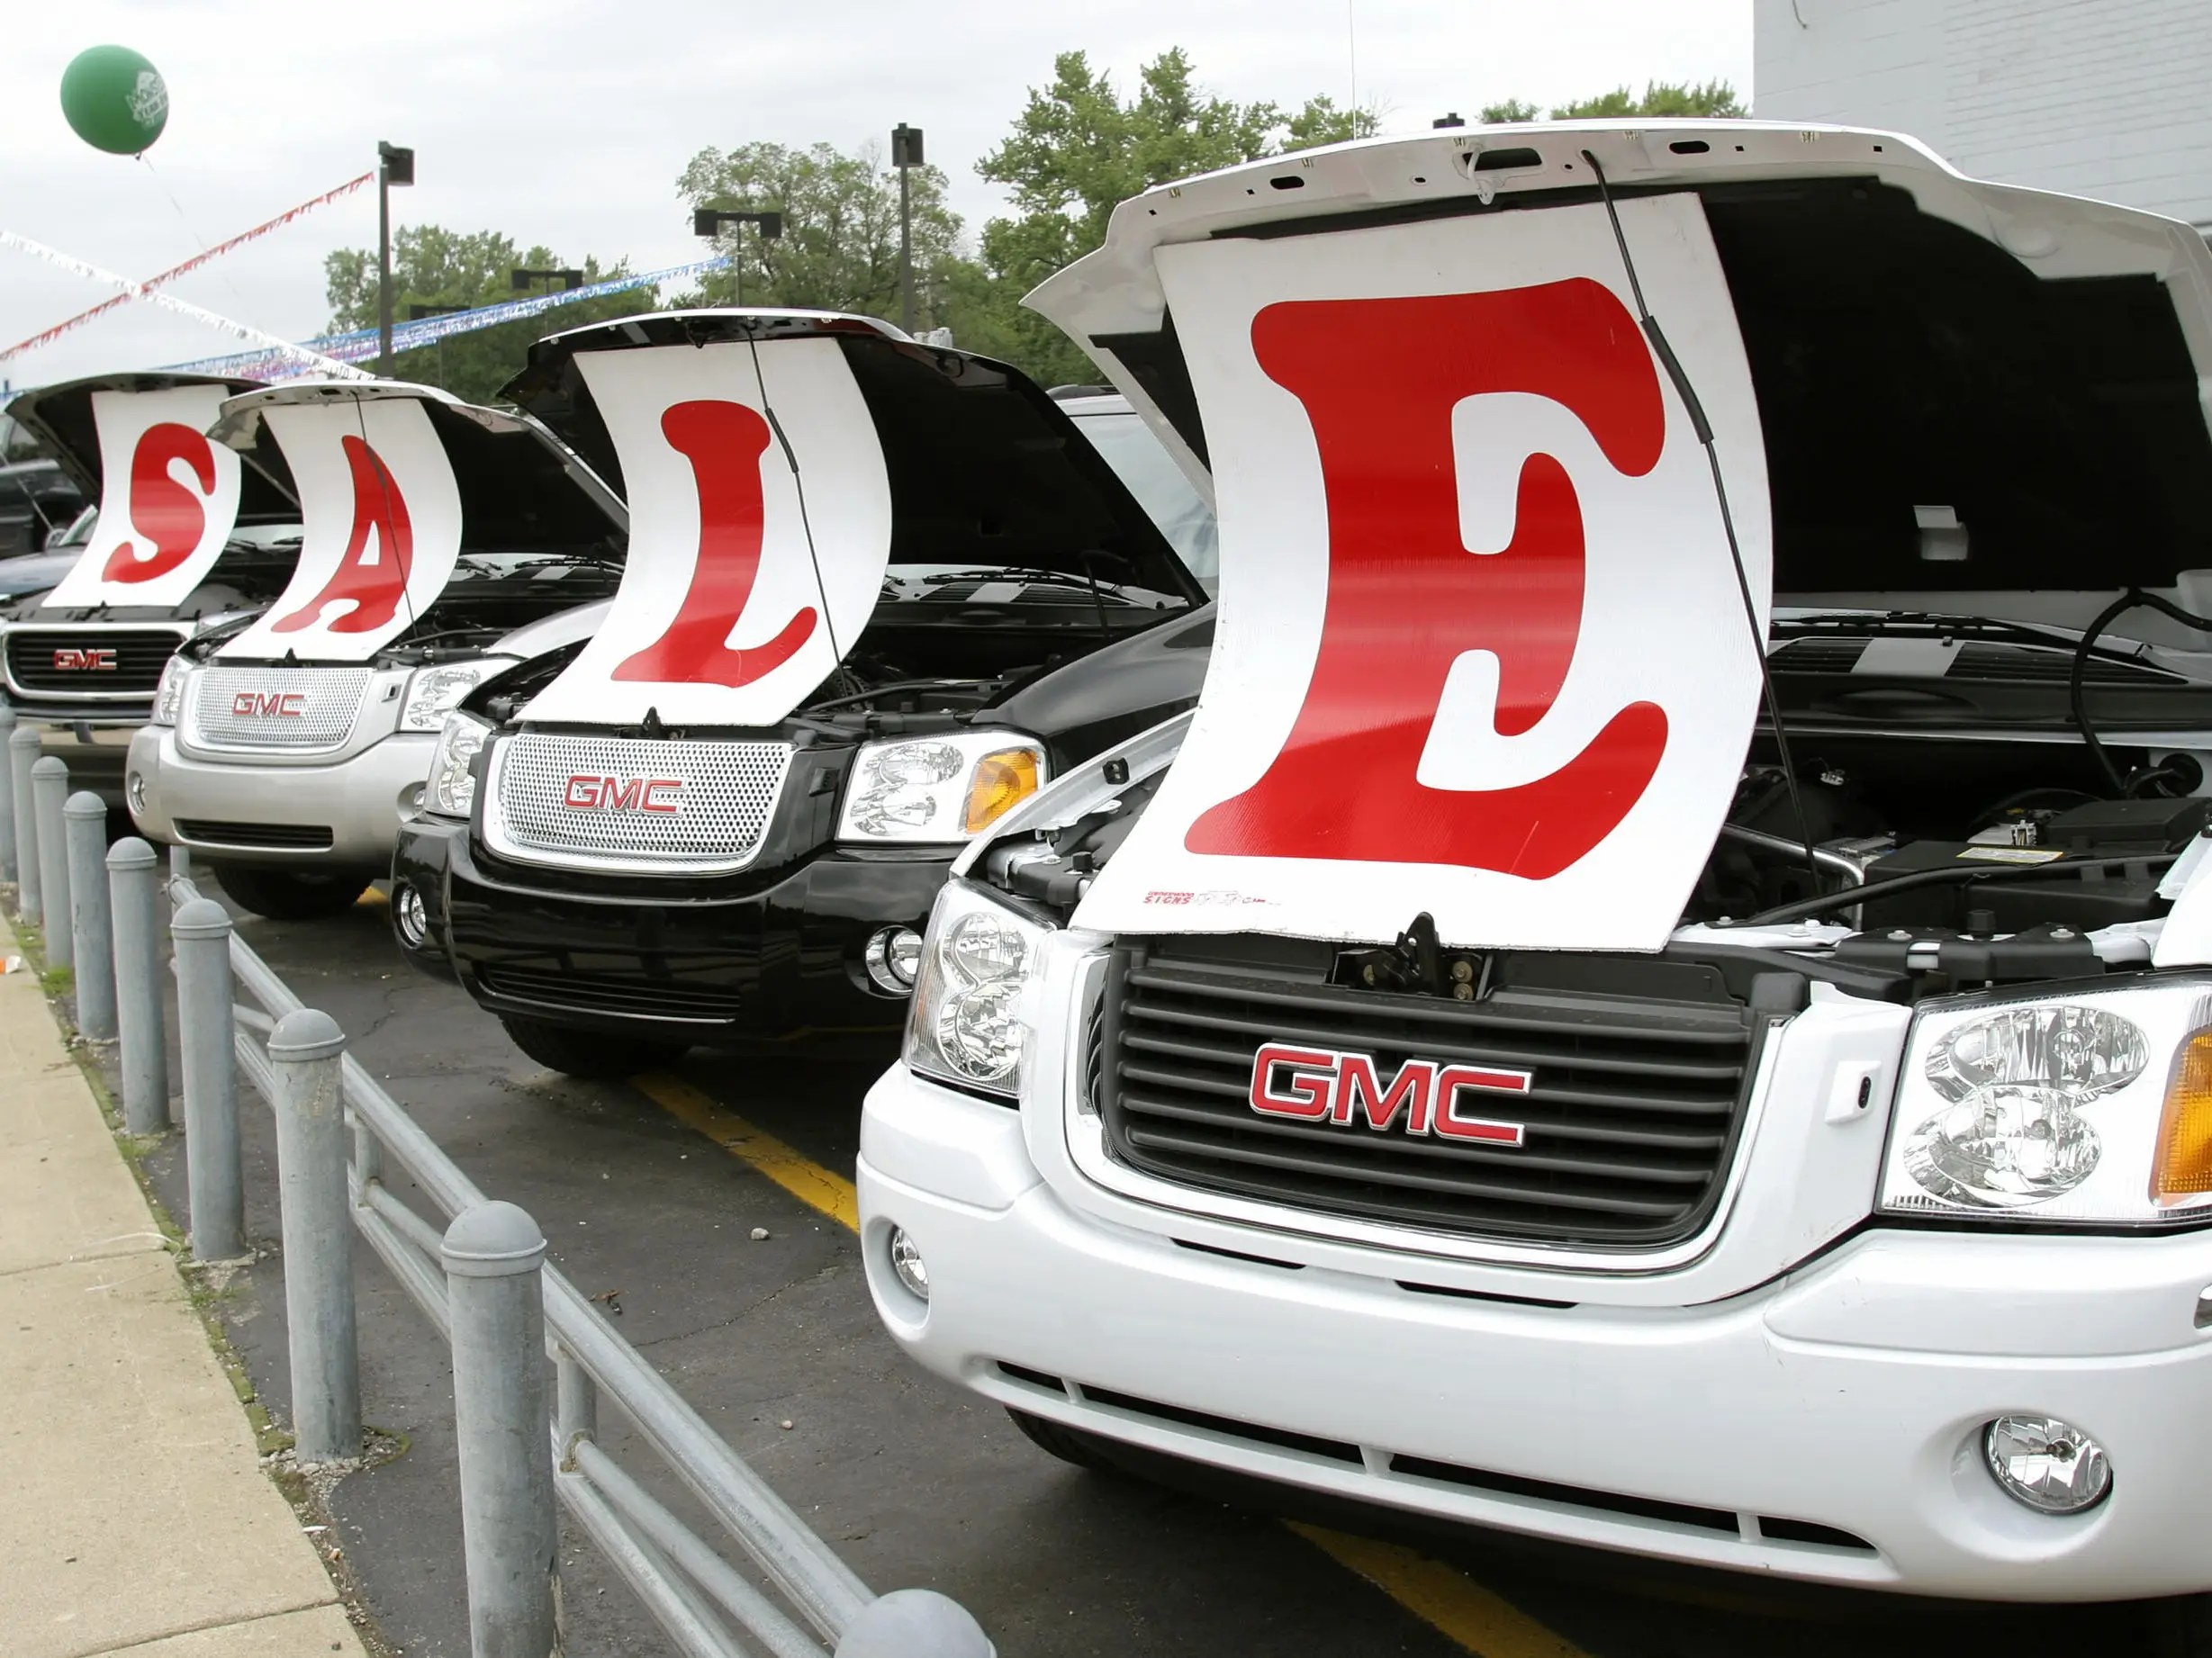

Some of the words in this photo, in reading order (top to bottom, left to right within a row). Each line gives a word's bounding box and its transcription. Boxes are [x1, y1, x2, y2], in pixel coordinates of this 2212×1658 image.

[53, 648, 117, 671] GMC
[231, 692, 305, 717] GMC
[563, 772, 687, 818] GMC
[1143, 896, 1191, 905] SIGNS
[1249, 1042, 1532, 1148] GMC
